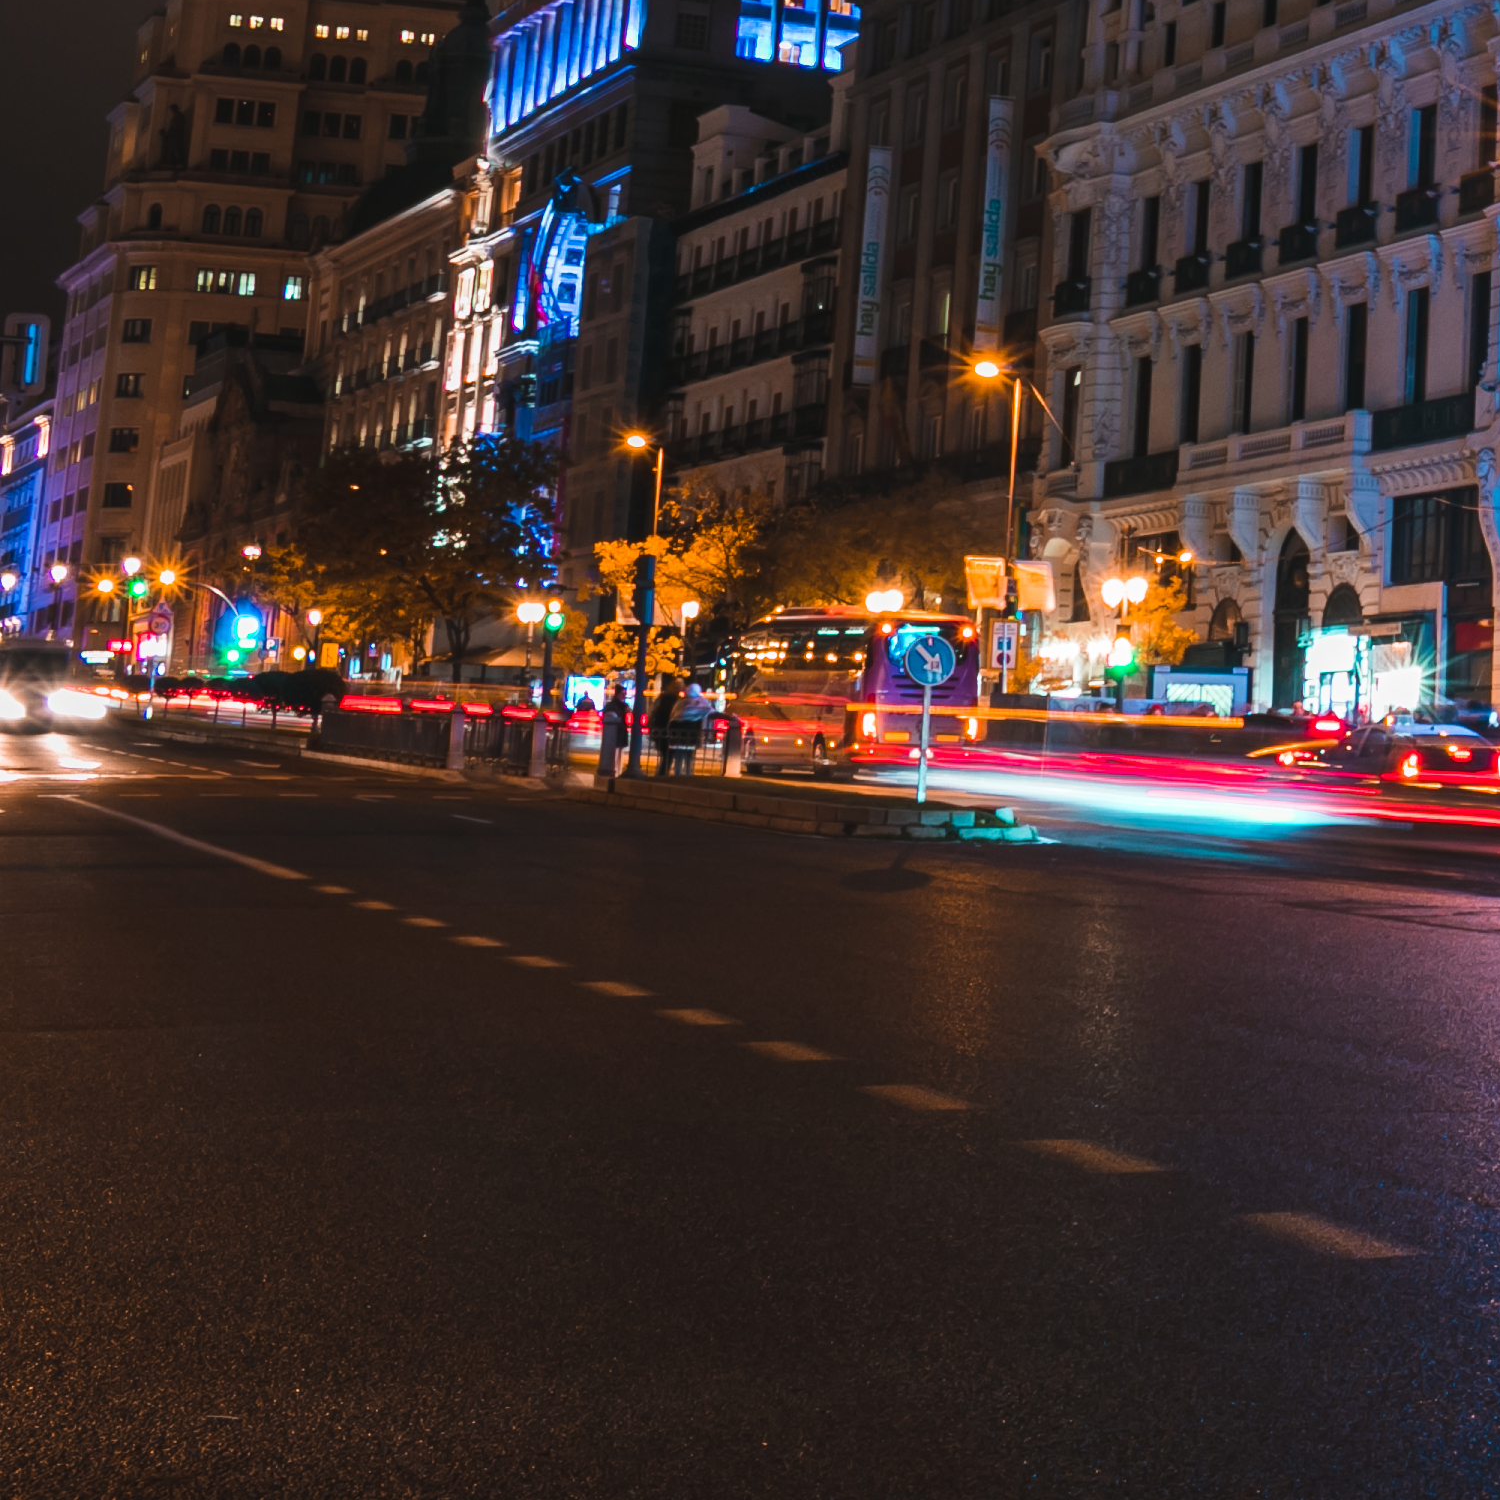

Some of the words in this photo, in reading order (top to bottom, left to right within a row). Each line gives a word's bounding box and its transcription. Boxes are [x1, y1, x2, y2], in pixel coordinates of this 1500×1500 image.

[982, 198, 1002, 257] salida
[861, 241, 880, 297] salida
[979, 262, 1002, 301] hay
[856, 300, 880, 337] hay
